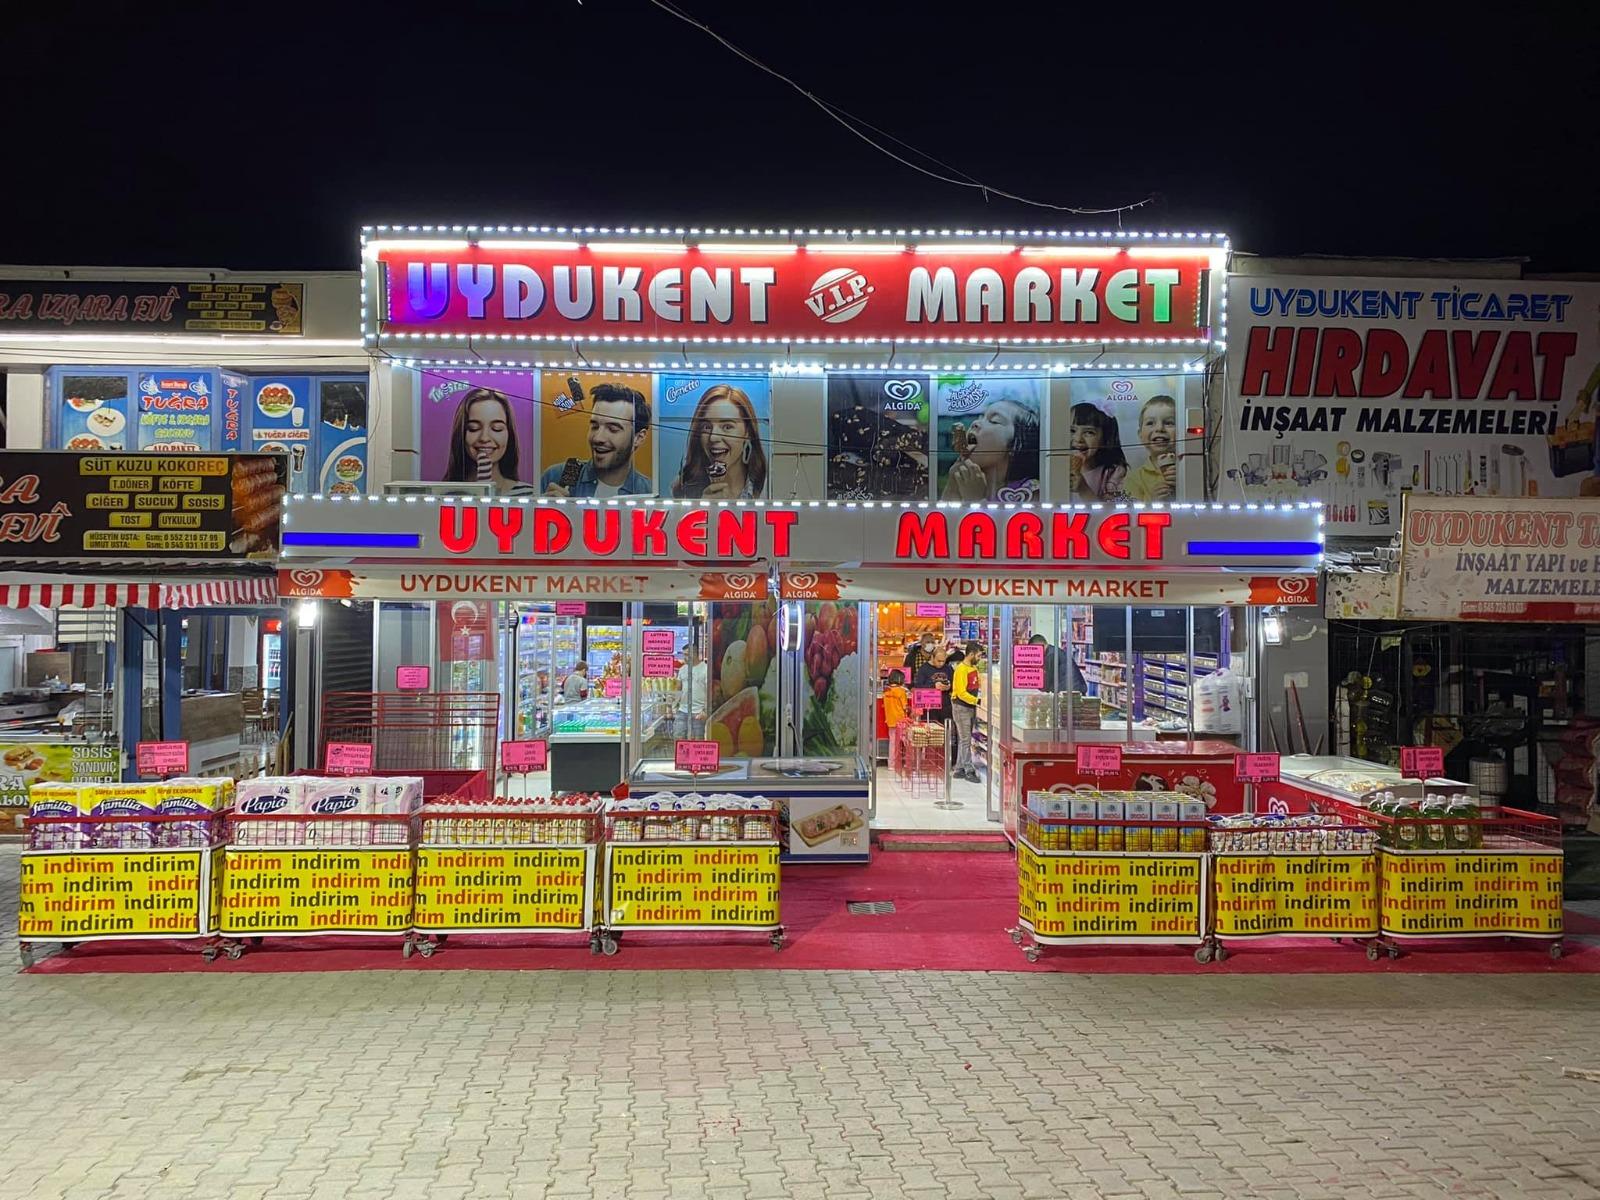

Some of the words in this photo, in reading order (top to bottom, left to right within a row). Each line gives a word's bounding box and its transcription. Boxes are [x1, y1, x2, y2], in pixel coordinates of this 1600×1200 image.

[407, 262, 776, 323] UYDUKENT
[905, 266, 1180, 324] MARKET
[804, 274, 875, 318] V.I.P.
[1250, 288, 1425, 319] UYDUKENT
[1431, 285, 1574, 322] TİCARET
[1240, 326, 1579, 401] HIRDAVAT
[142, 392, 208, 410] TUĞRA
[1240, 398, 1347, 439] İNŞAAT
[1356, 404, 1559, 435] MALZEMELERİ
[85, 458, 111, 472] SÜT
[117, 460, 151, 472] KUZU
[158, 460, 225, 475] KOKOREÇ
[113, 479, 150, 489] T.DÖNER
[162, 479, 194, 490] KÖFTE
[92, 496, 124, 507] CİĞER
[138, 497, 174, 506] SUCUK
[188, 497, 219, 507] SOSİS
[120, 516, 140, 525] TOST
[162, 515, 197, 525] UYKULUK
[439, 505, 798, 560] UYDUKENT
[896, 511, 1171, 561] MARKET
[1410, 510, 1574, 548] UYDUKENT
[1456, 549, 1521, 576] İNŞAAT
[1525, 553, 1566, 572] YAPI
[1570, 558, 1588, 572] ve
[400, 574, 538, 594] UYDUKENT
[547, 575, 649, 594] MARKET
[925, 577, 1058, 598] UYDUKENT
[1067, 579, 1169, 598] MARKET
[72, 746, 112, 759] SOSİS
[33, 800, 73, 816] familia
[100, 799, 142, 815] familia
[161, 799, 198, 813] familia
[246, 796, 286, 814] Papia
[315, 796, 357, 814] Papia
[44, 858, 114, 874] indirim
[124, 857, 194, 873] indirim
[292, 854, 360, 870] indirim
[438, 853, 504, 867] indirim
[514, 852, 580, 867] indirim
[617, 850, 682, 865] indirim
[694, 850, 758, 865] indirim
[1386, 856, 1446, 874] indirim
[1455, 858, 1518, 873] indirim
[1055, 860, 1120, 876] indirim
[1130, 862, 1193, 876] indirim
[1286, 859, 1349, 874] indirim
[230, 874, 300, 890] indirim
[312, 873, 380, 889] indirim
[455, 871, 521, 886] indirim
[637, 869, 702, 884] indirim
[712, 868, 775, 883] indirim
[1401, 877, 1463, 892] indirim
[1474, 876, 1539, 892] indirim
[64, 877, 133, 892] indirim
[1073, 879, 1137, 895] indirim
[1232, 877, 1294, 893] indirim
[1305, 876, 1370, 892] indirim
[290, 891, 359, 907] indirim
[437, 890, 503, 905] indirim
[513, 889, 578, 904] indirim
[617, 887, 681, 901] indirim
[693, 886, 757, 901] indirim
[1384, 893, 1446, 910] indirim
[1455, 894, 1518, 909] indirim
[45, 895, 115, 912] indirim
[125, 894, 193, 910] indirim
[1056, 897, 1119, 912] indirim
[1129, 898, 1193, 913] indirim
[1285, 895, 1350, 910] indirim
[229, 911, 298, 928] indirim
[310, 909, 378, 926] indirim
[454, 908, 520, 924] indirim
[636, 905, 700, 920] indirim
[711, 905, 774, 920] indirim
[61, 914, 133, 932] indirim
[1073, 917, 1137, 931] indirim
[1234, 913, 1293, 930] indirim
[1304, 913, 1371, 928] indirim
[1401, 913, 1463, 929] indirim
[1474, 913, 1540, 929] indirim
